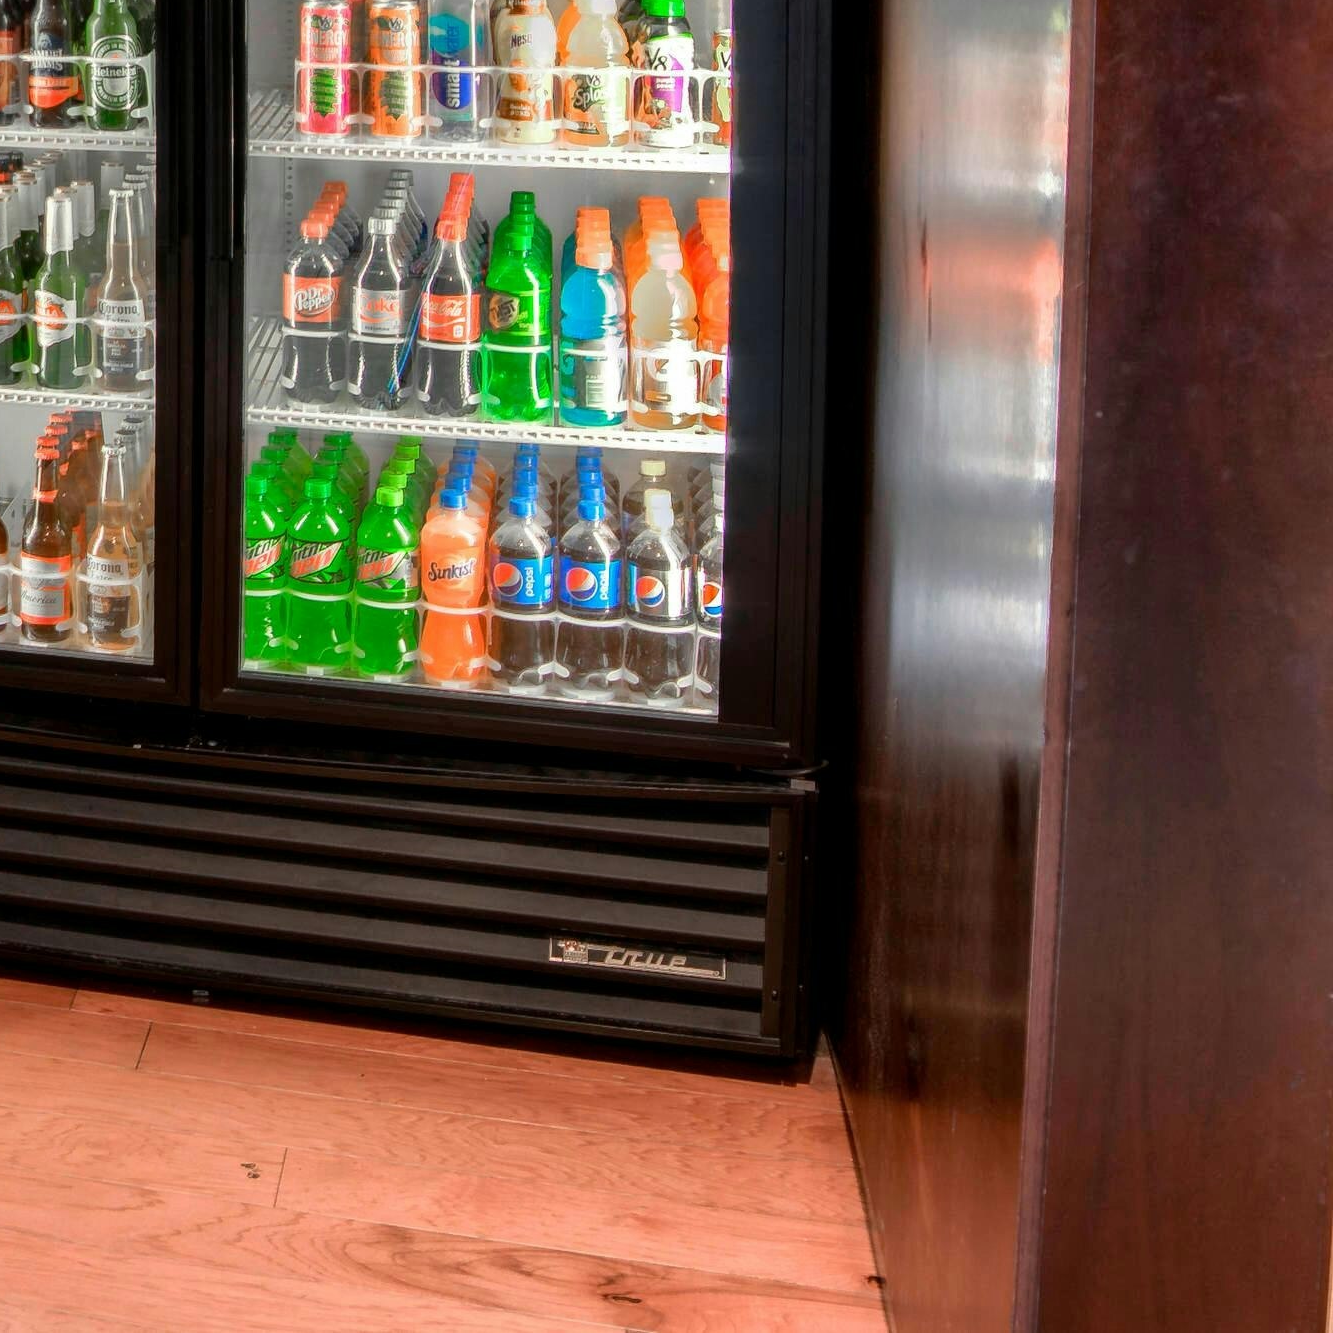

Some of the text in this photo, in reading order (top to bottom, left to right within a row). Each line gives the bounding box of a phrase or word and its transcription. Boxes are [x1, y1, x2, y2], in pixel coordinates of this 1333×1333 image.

[648, 47, 668, 71] V8
[295, 291, 335, 313] Pepper
[306, 286, 323, 299] Dr
[98, 299, 141, 317] Corona
[87, 556, 123, 575] Corona
[427, 559, 476, 583] Sunkist
[524, 566, 535, 597] pepsi
[599, 569, 609, 601] pepsi
